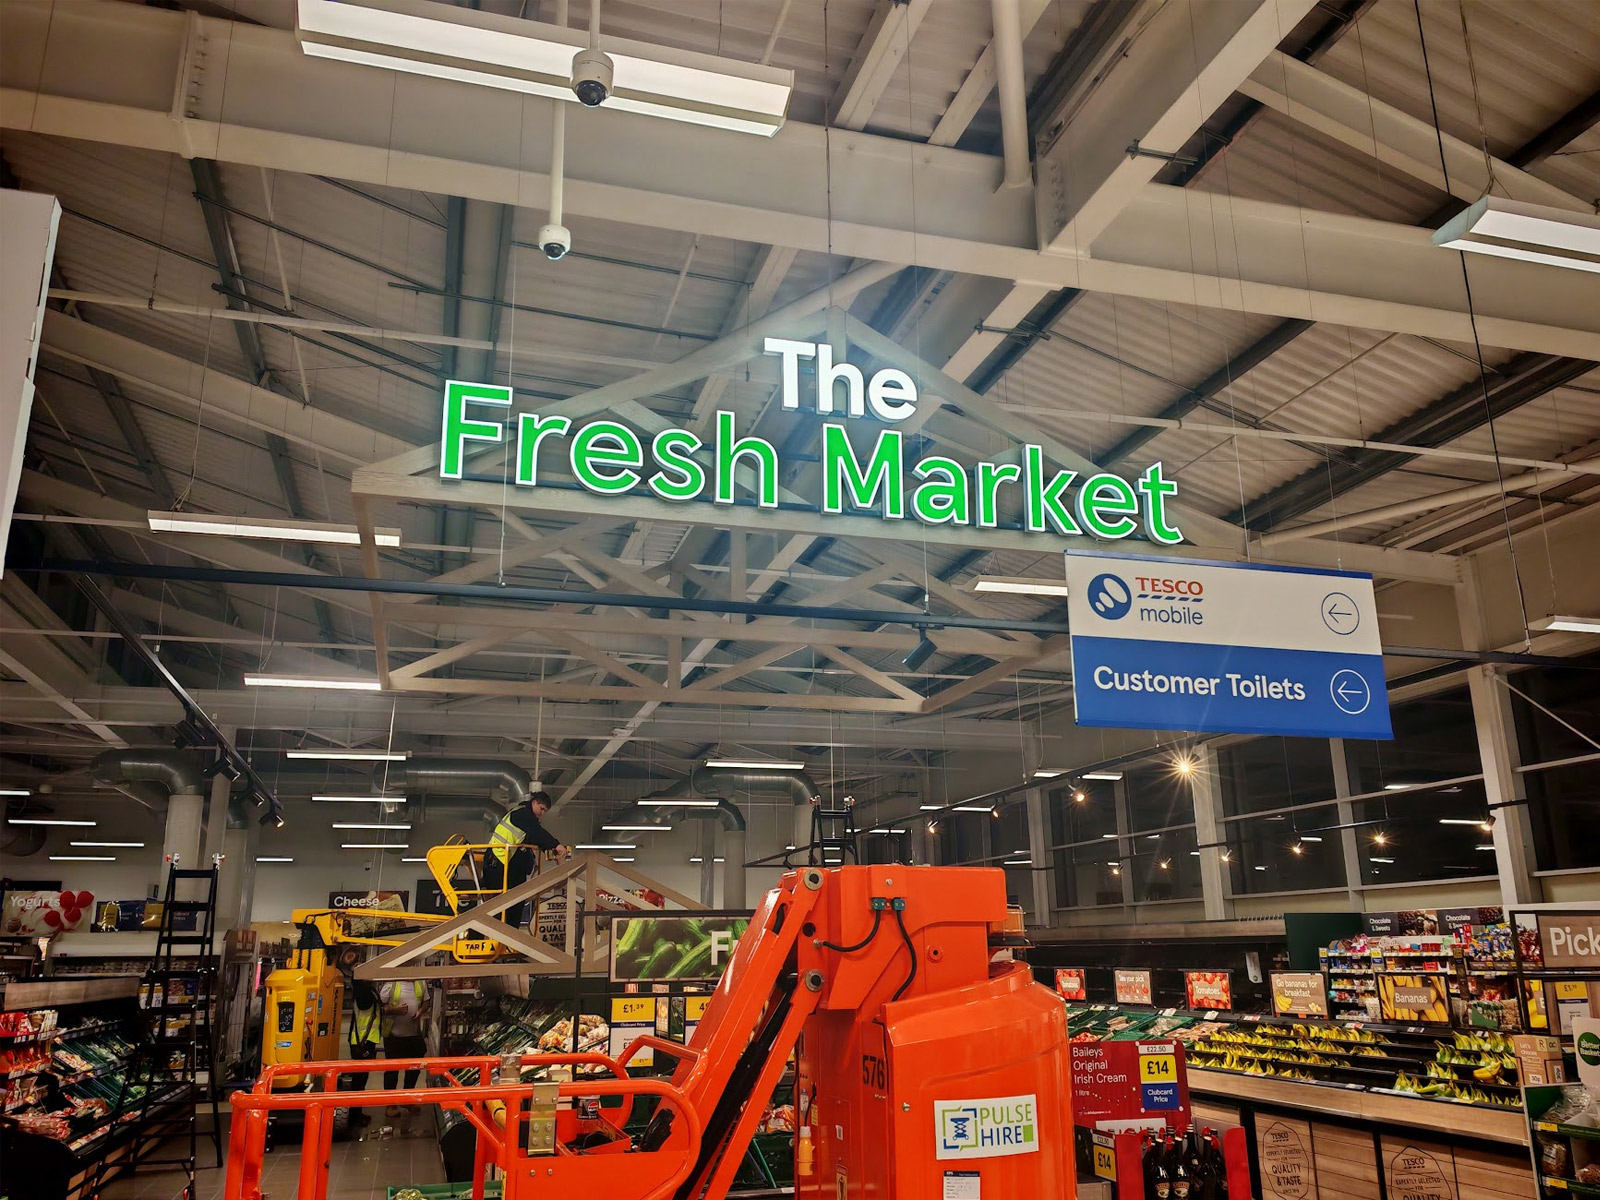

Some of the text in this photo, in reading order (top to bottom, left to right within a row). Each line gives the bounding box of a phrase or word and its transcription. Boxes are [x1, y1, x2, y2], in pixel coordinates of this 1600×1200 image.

[763, 337, 918, 421] The
[440, 379, 1185, 545] Fresh Market
[1135, 577, 1204, 596] TESCO
[1140, 606, 1204, 625] mobile
[1094, 665, 1306, 701] Customer Toilets
[10, 896, 61, 912] Yogurts
[334, 896, 380, 907] Cheese
[1369, 917, 1392, 925] Chocolate
[1445, 914, 1471, 922] Chocolate
[1549, 926, 1600, 956] Pick
[1275, 979, 1318, 988] Go bananas for
[1195, 986, 1221, 995] Tomatoes
[1284, 989, 1312, 998] breakfast
[1395, 992, 1428, 1004] Bananas
[623, 1003, 644, 1013] £1.39
[1072, 1047, 1104, 1058] Baileys
[862, 1054, 885, 1090] 576
[1073, 1060, 1108, 1073] Original
[1147, 1060, 1170, 1075] £14
[1074, 1073, 1127, 1085] Irish Cream
[1147, 1088, 1173, 1096] Clubcard
[980, 1103, 1033, 1126] PULSE
[981, 1126, 1023, 1147] HIRE
[1097, 1152, 1111, 1170] £14
[1402, 1157, 1425, 1166] TESCO
[1271, 1164, 1301, 1174] QUALITY
[1283, 1176, 1302, 1186] TASTE
